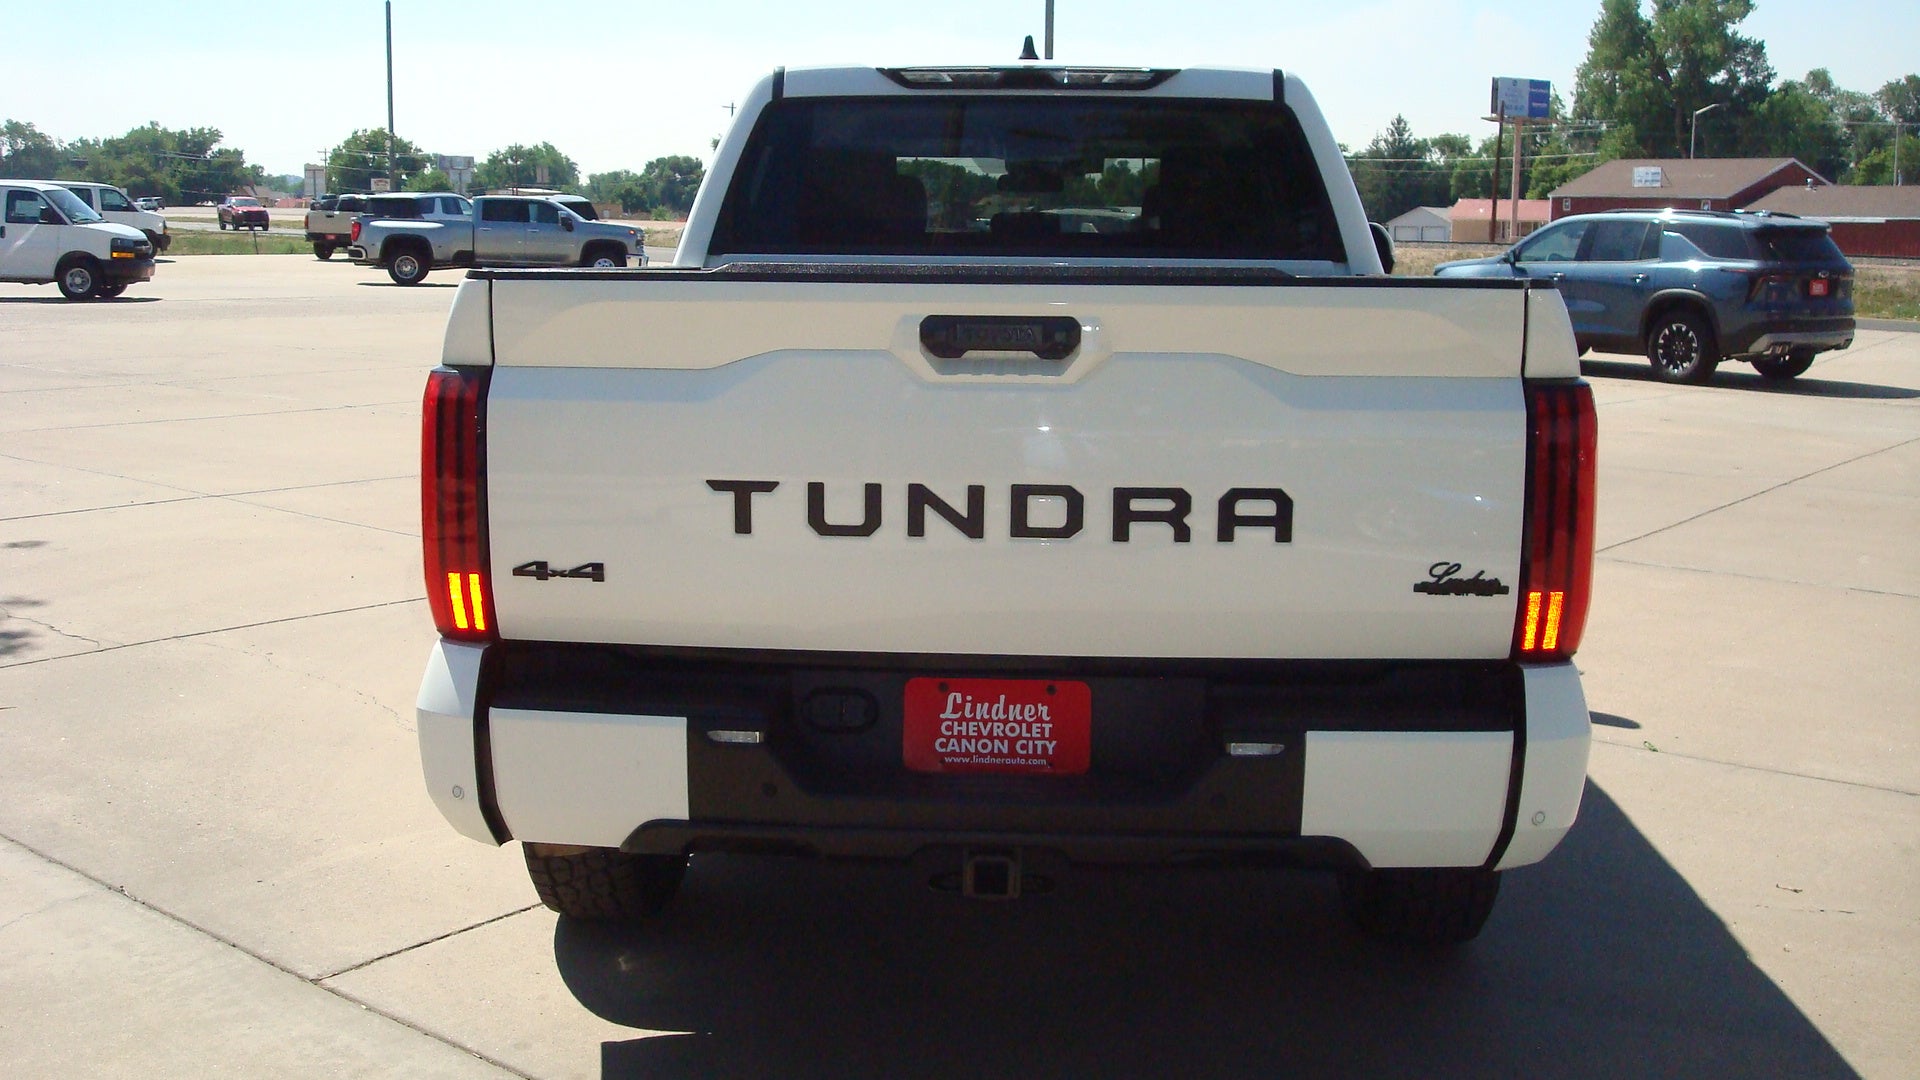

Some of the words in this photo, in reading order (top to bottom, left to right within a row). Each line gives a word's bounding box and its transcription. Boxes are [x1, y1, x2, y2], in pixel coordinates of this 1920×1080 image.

[706, 480, 1293, 543] TUNDRA
[513, 561, 604, 582] 4x4
[940, 692, 1050, 722] Lindner
[940, 722, 1053, 738] CHEVROLET
[935, 738, 1009, 754] CANON
[1015, 740, 1057, 755] CITY
[944, 755, 1047, 766] www.lindnerauto.com
